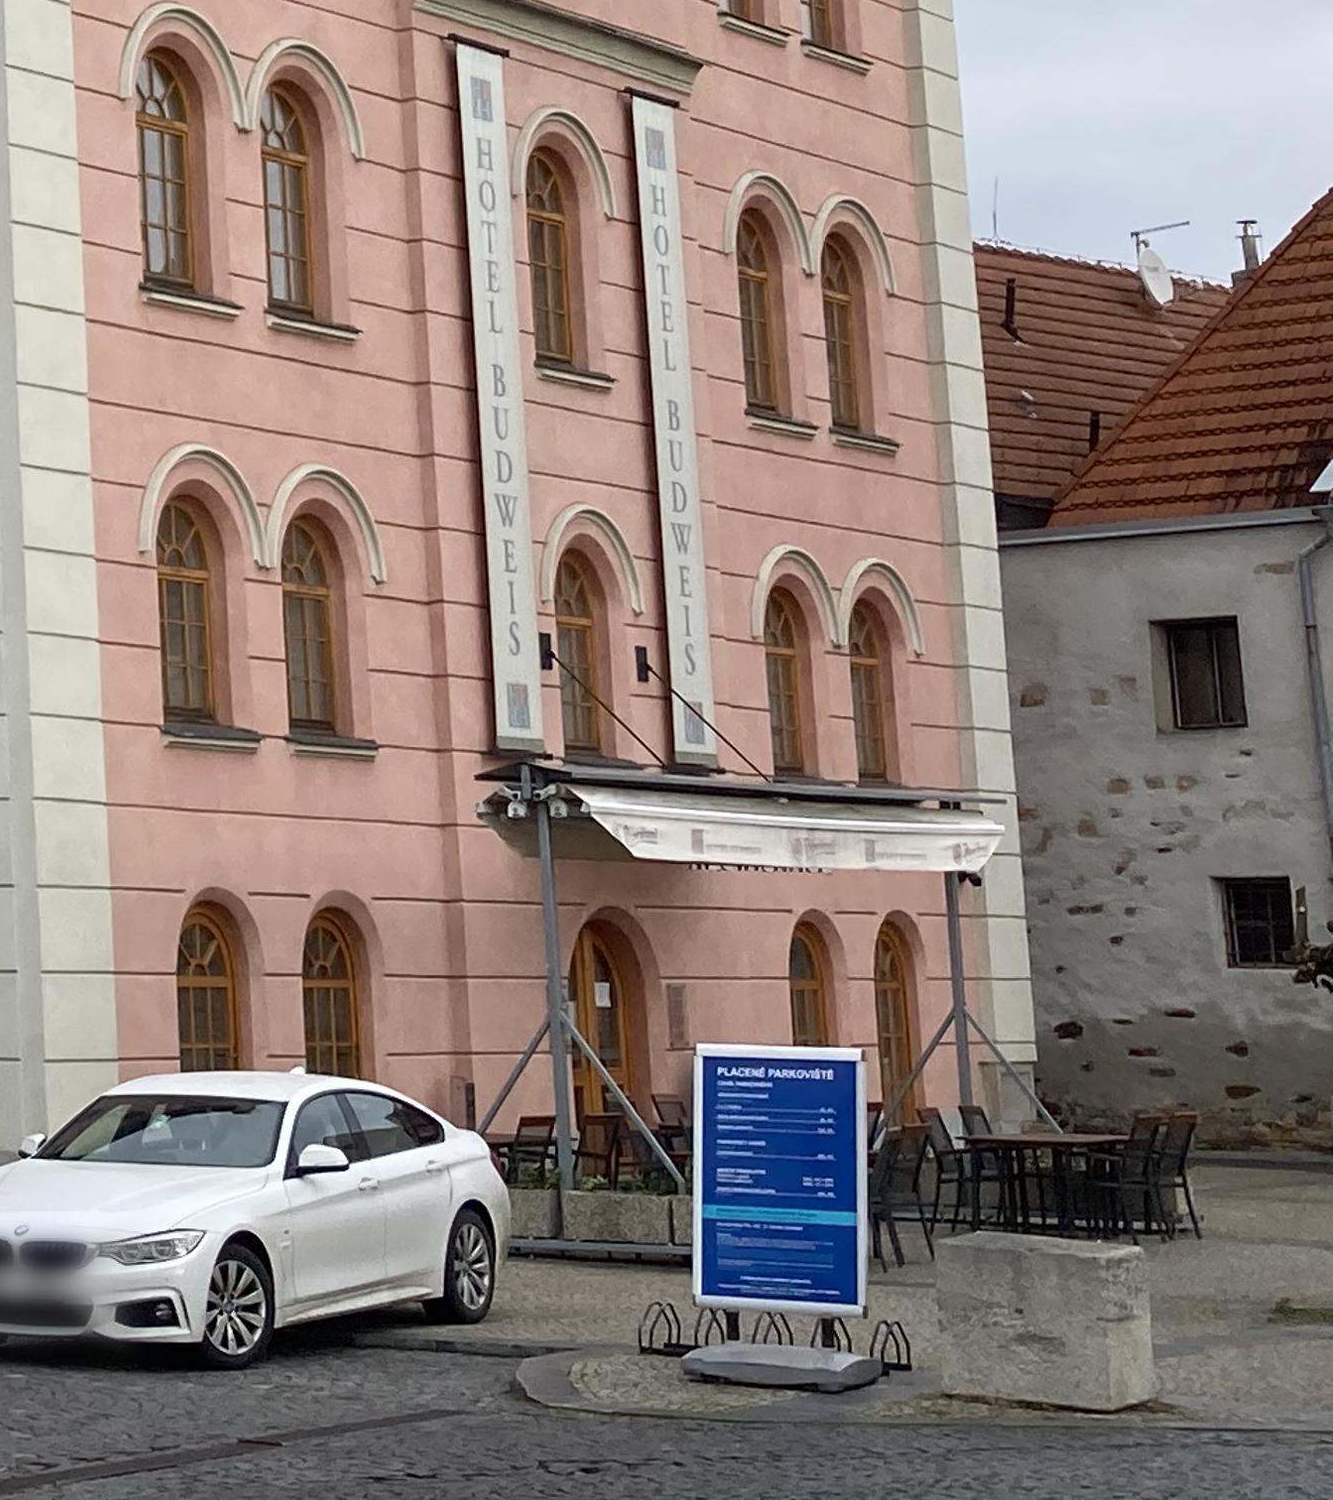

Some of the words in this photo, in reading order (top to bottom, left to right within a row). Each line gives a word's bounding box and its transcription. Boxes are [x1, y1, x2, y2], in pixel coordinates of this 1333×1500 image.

[475, 136, 503, 335] HOTEL
[491, 363, 522, 657] BUDWEIS
[649, 183, 677, 373] HOTEL
[666, 398, 697, 676] BUDWEIS
[716, 1066, 766, 1078] PLACENÉ
